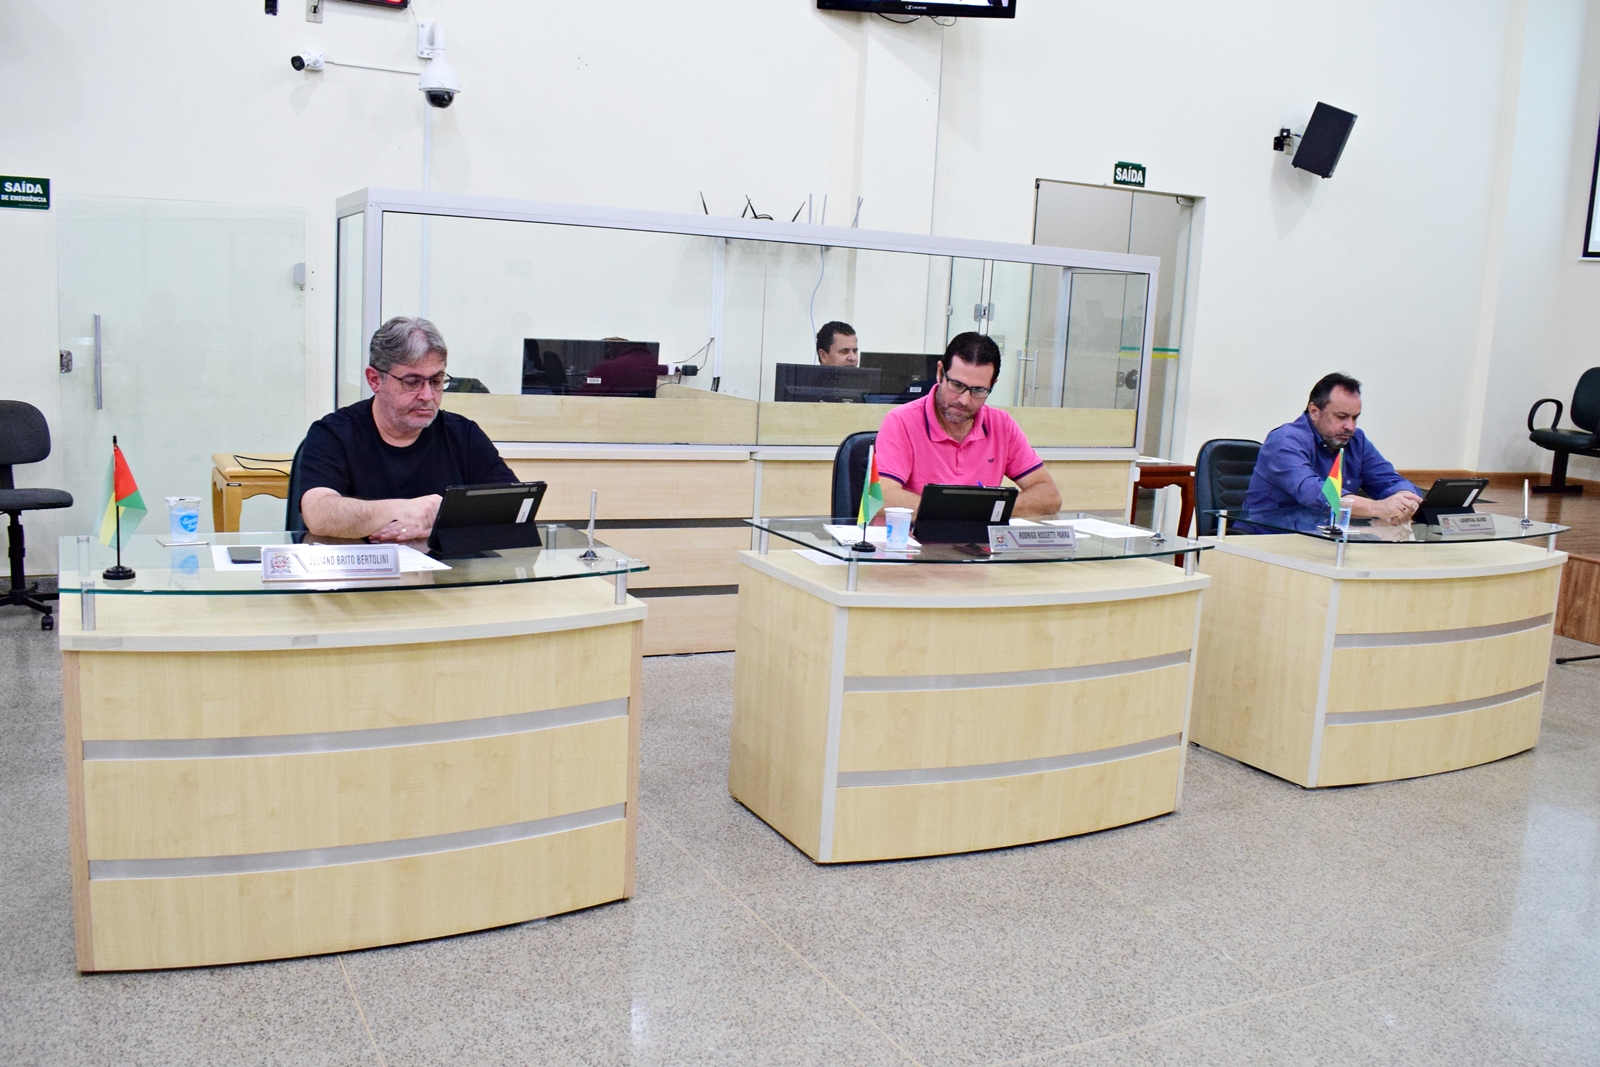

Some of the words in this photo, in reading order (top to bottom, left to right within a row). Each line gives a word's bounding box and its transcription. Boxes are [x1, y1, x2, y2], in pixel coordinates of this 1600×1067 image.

[1115, 166, 1143, 183] SAÍDA
[4, 181, 44, 194] SAÍDA
[10, 195, 47, 203] EMERGÊNCIA
[1018, 531, 1037, 539] RODRIGO
[309, 555, 335, 565] JULIANO
[336, 555, 355, 565] BRITO
[356, 554, 389, 565] BERTOLINI
